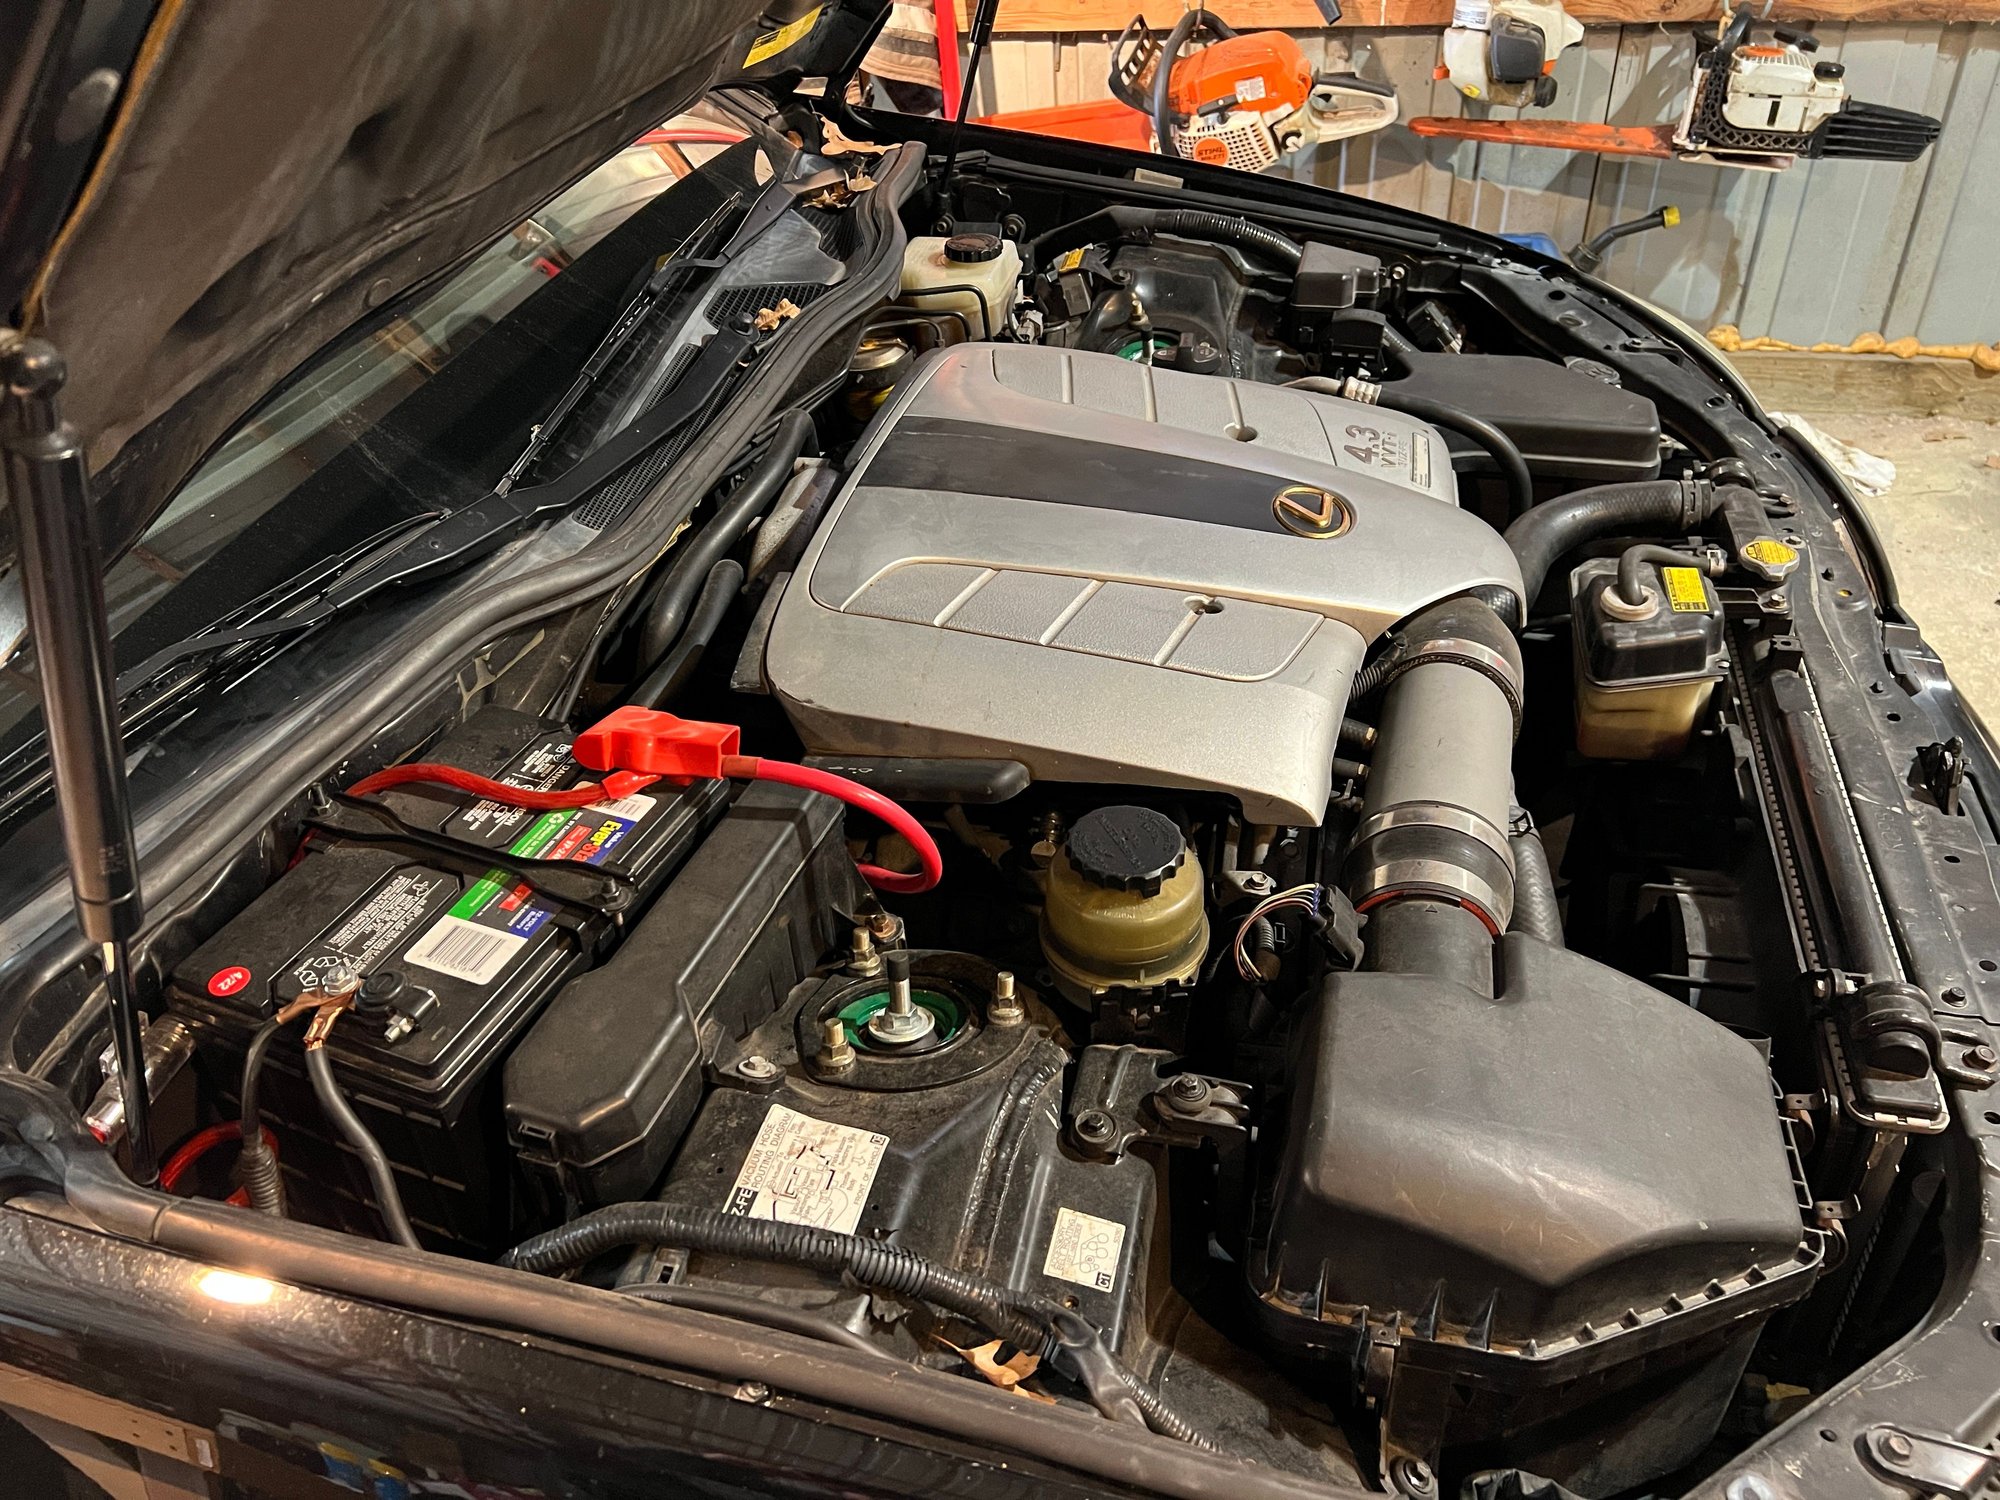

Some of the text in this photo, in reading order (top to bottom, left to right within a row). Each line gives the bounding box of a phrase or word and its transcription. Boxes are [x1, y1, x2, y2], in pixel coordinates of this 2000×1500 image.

[1198, 147, 1225, 157] STIHL
[1344, 424, 1380, 464] 4.3
[1381, 431, 1397, 467] VVT-i
[504, 808, 527, 826] ISON
[572, 820, 623, 862] EverSta
[604, 832, 624, 848] Value
[523, 911, 544, 931] 12-VOLT
[217, 972, 243, 991] 4/22
[739, 1122, 775, 1185] VACUUM HOSE
[750, 1149, 775, 1188] ROUTING
[769, 1112, 791, 1146] DIAGRAM
[853, 1146, 880, 1204] FRONT OF VEHICLE
[729, 1188, 753, 1216] Z-FE
[1097, 1273, 1110, 1288] CT
